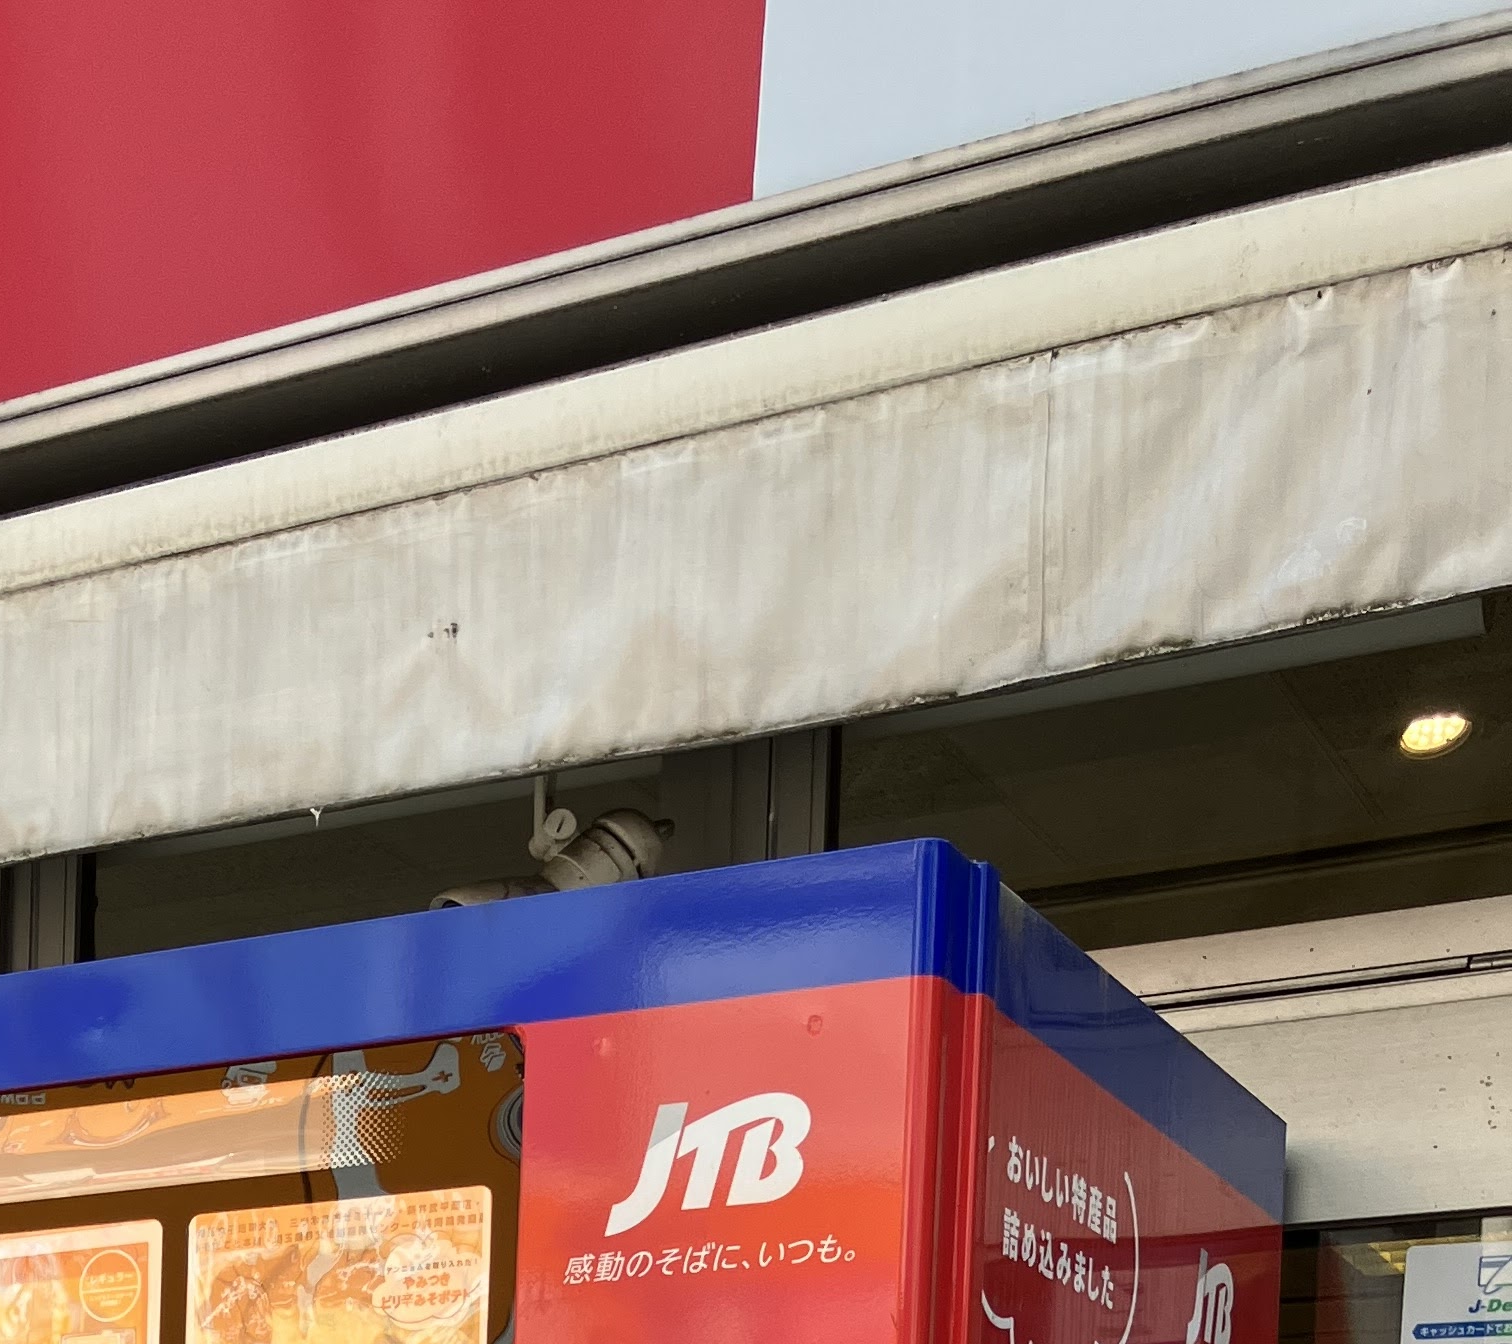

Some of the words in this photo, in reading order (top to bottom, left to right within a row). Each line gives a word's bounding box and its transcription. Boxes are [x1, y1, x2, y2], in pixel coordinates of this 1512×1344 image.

[604, 1092, 811, 1237] JTB
[1007, 1136, 1117, 1245] おいしい特産品
[563, 1234, 856, 1285] 感動のそばに、いつも。
[1002, 1208, 1115, 1310] 詰め込みました
